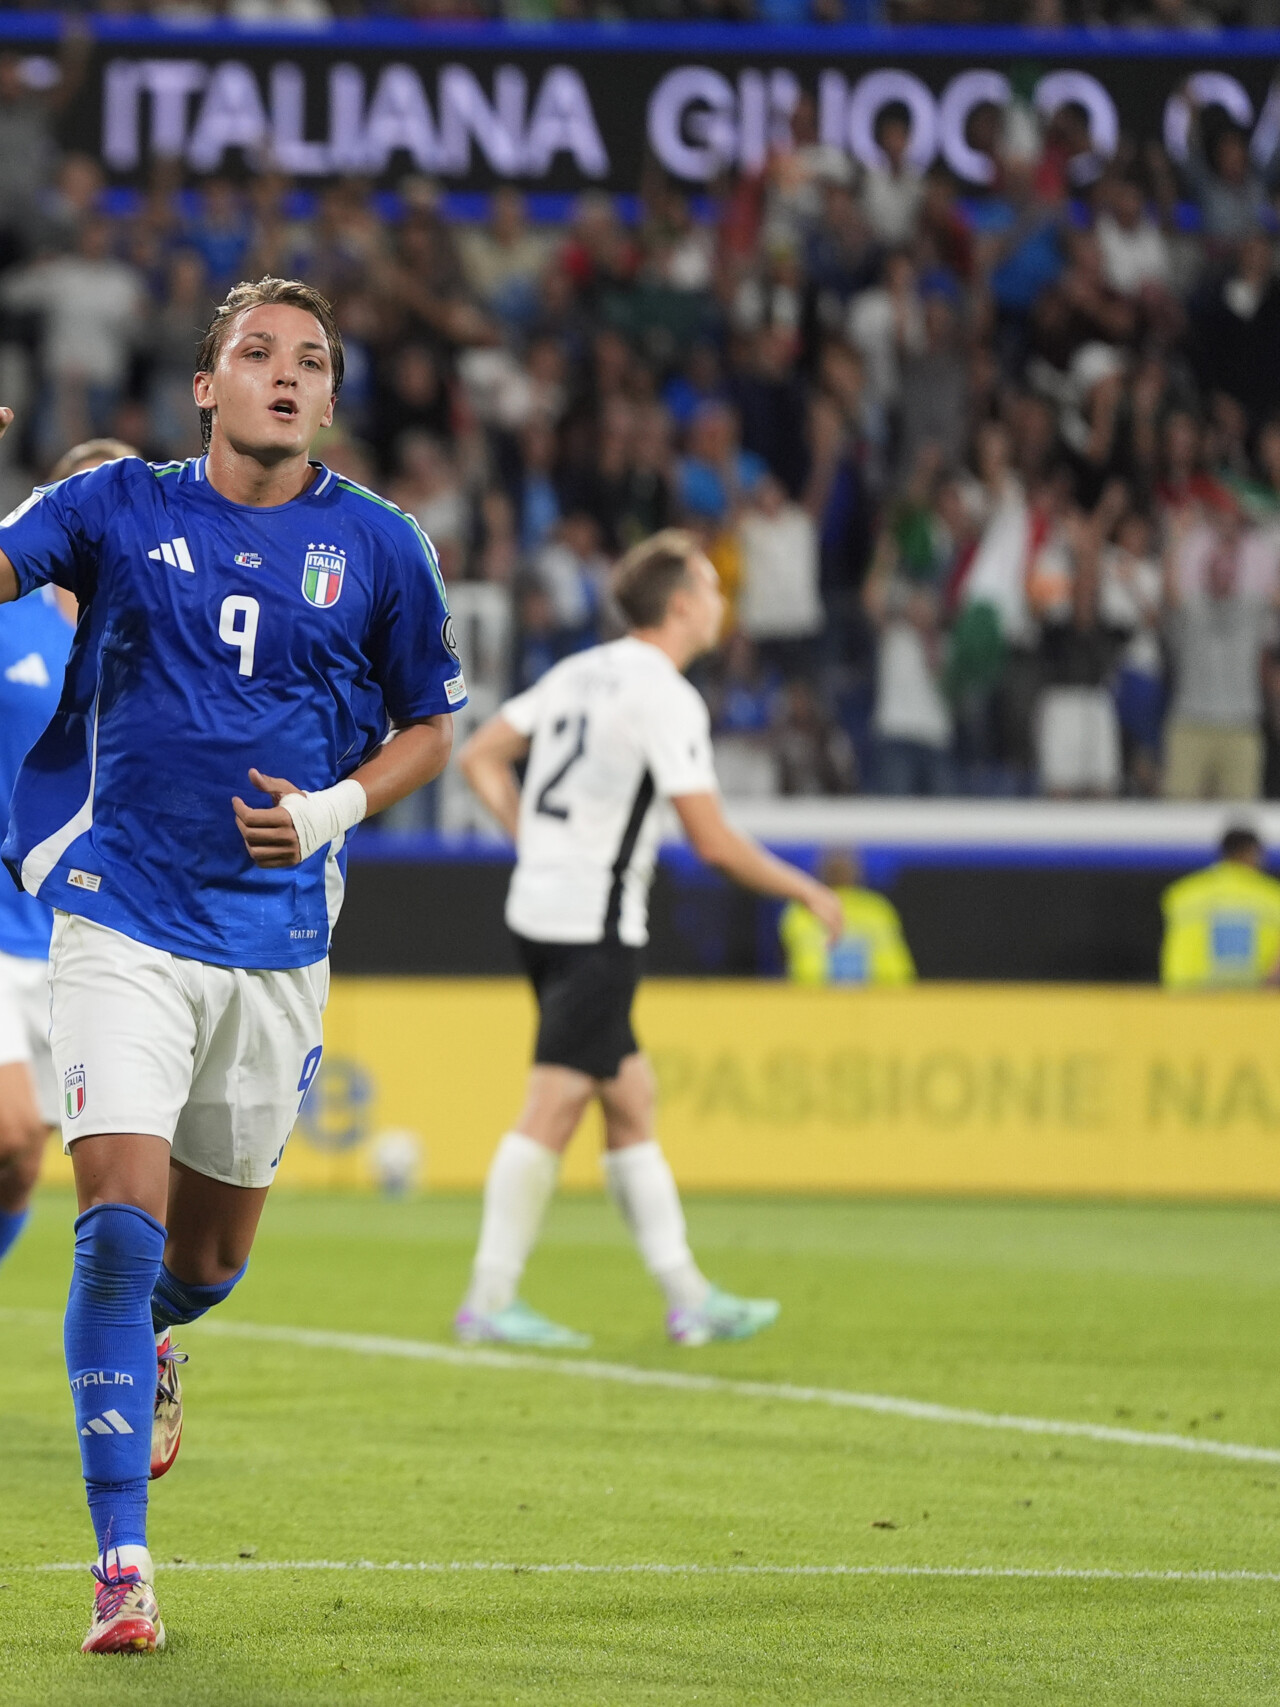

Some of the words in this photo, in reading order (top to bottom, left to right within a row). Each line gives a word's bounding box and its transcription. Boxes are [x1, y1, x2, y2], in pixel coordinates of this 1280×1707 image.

[102, 56, 610, 180] ITALIANA
[308, 555, 341, 571] ITALIA
[218, 594, 260, 678] 9
[535, 712, 587, 821] 2
[648, 1046, 1108, 1130] PASSIONE
[70, 1370, 134, 1391] ITALIA
